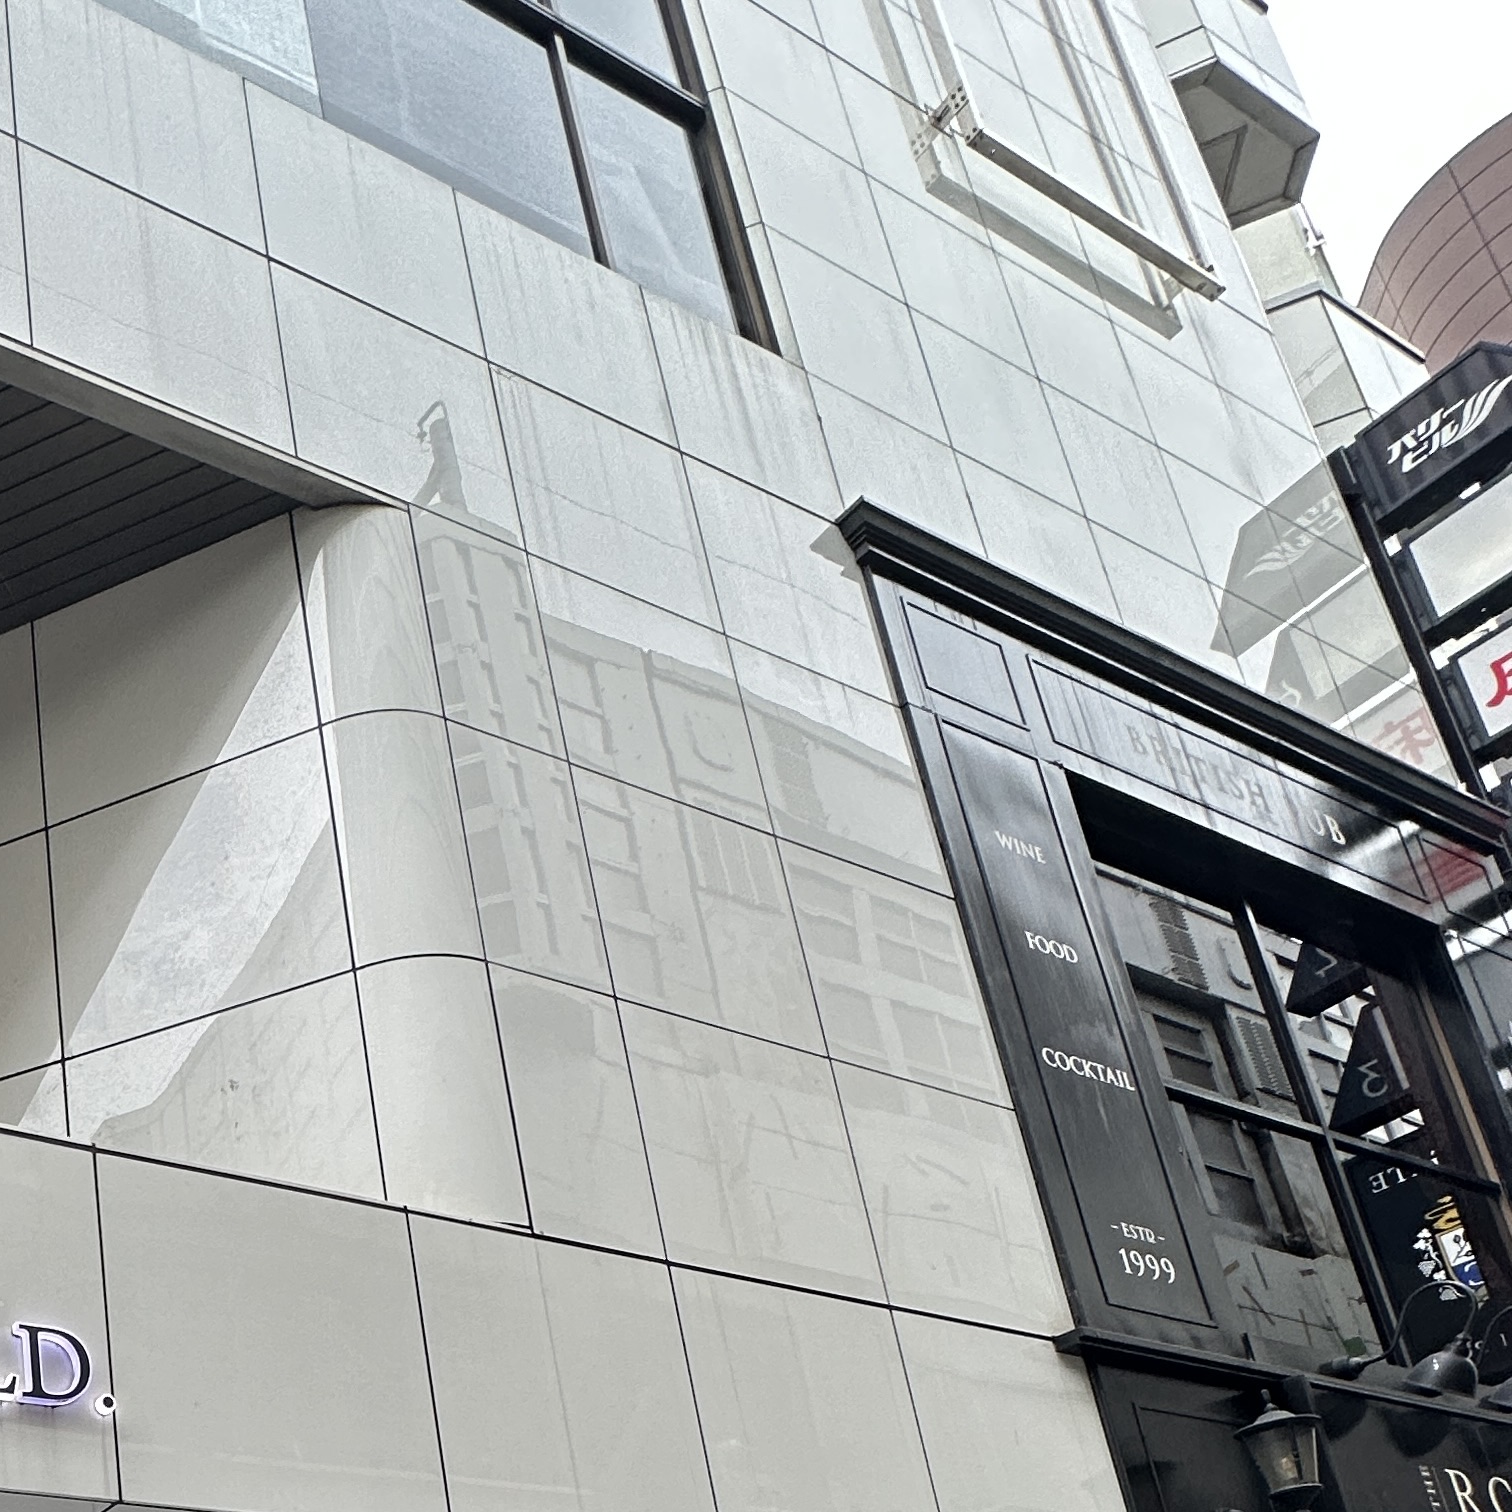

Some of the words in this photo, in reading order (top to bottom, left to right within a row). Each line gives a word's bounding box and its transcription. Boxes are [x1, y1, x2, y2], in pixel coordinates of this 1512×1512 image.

[995, 829, 1047, 865] WINE
[1024, 929, 1079, 964] FOOD
[1041, 1046, 1136, 1091] COCKTAIL
[1118, 1247, 1176, 1284] 1999
